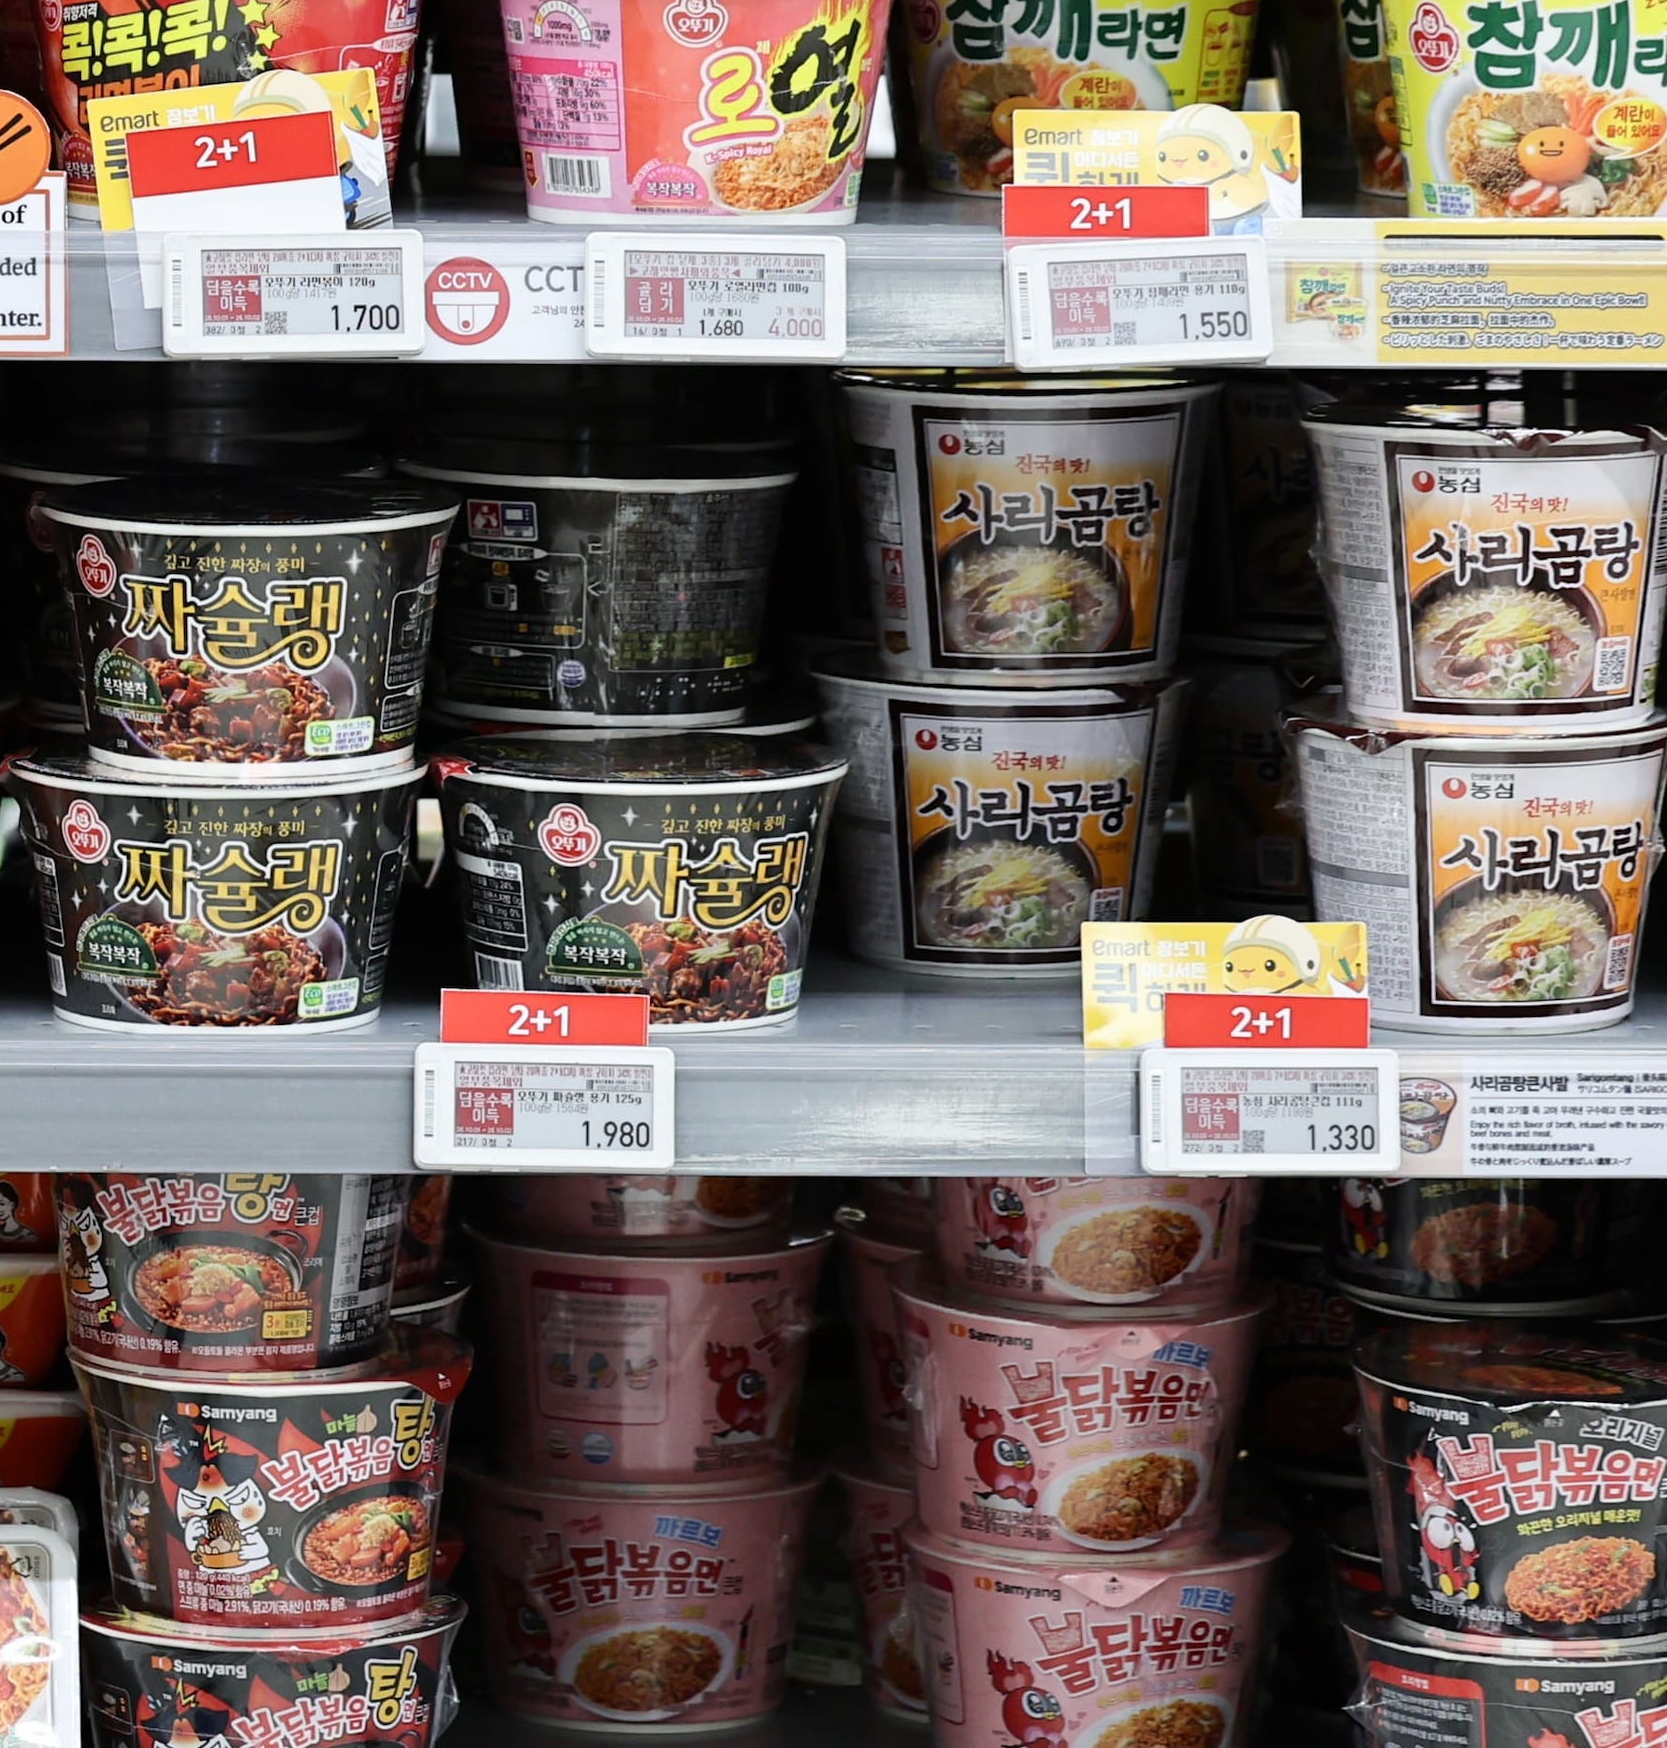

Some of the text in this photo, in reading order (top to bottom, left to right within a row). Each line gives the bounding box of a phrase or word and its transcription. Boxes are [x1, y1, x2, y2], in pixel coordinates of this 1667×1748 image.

[194, 137, 258, 170] 2+1
[1, 205, 26, 224] of
[1069, 198, 1133, 230] 2+1
[438, 272, 492, 290] CCTV
[329, 305, 401, 333] 1,700
[768, 320, 824, 338] 4,000
[1178, 310, 1248, 340] 1,550
[943, 484, 1165, 547] 사리곰탕
[1415, 522, 1641, 587] 사리곰탕
[123, 577, 349, 671] 짜슐랭
[919, 778, 1135, 843] 사리곰탕
[1441, 824, 1645, 890] 사리곰탕
[117, 840, 338, 933] 짜슐랭
[604, 837, 806, 931] 짜슐랭
[508, 1004, 570, 1037] 2+1
[1230, 1007, 1292, 1040] 2+1
[1471, 1076, 1569, 1092] 사리곰탕큰사발
[582, 1121, 651, 1149] 1,980
[1307, 1125, 1376, 1152] 1,330
[968, 1329, 1034, 1351] Samyang
[201, 1405, 277, 1422] Samyang
[998, 1359, 1214, 1447] 불닭볶음면
[173, 1660, 248, 1679] Samyang
[1539, 1677, 1615, 1696] Samyang
